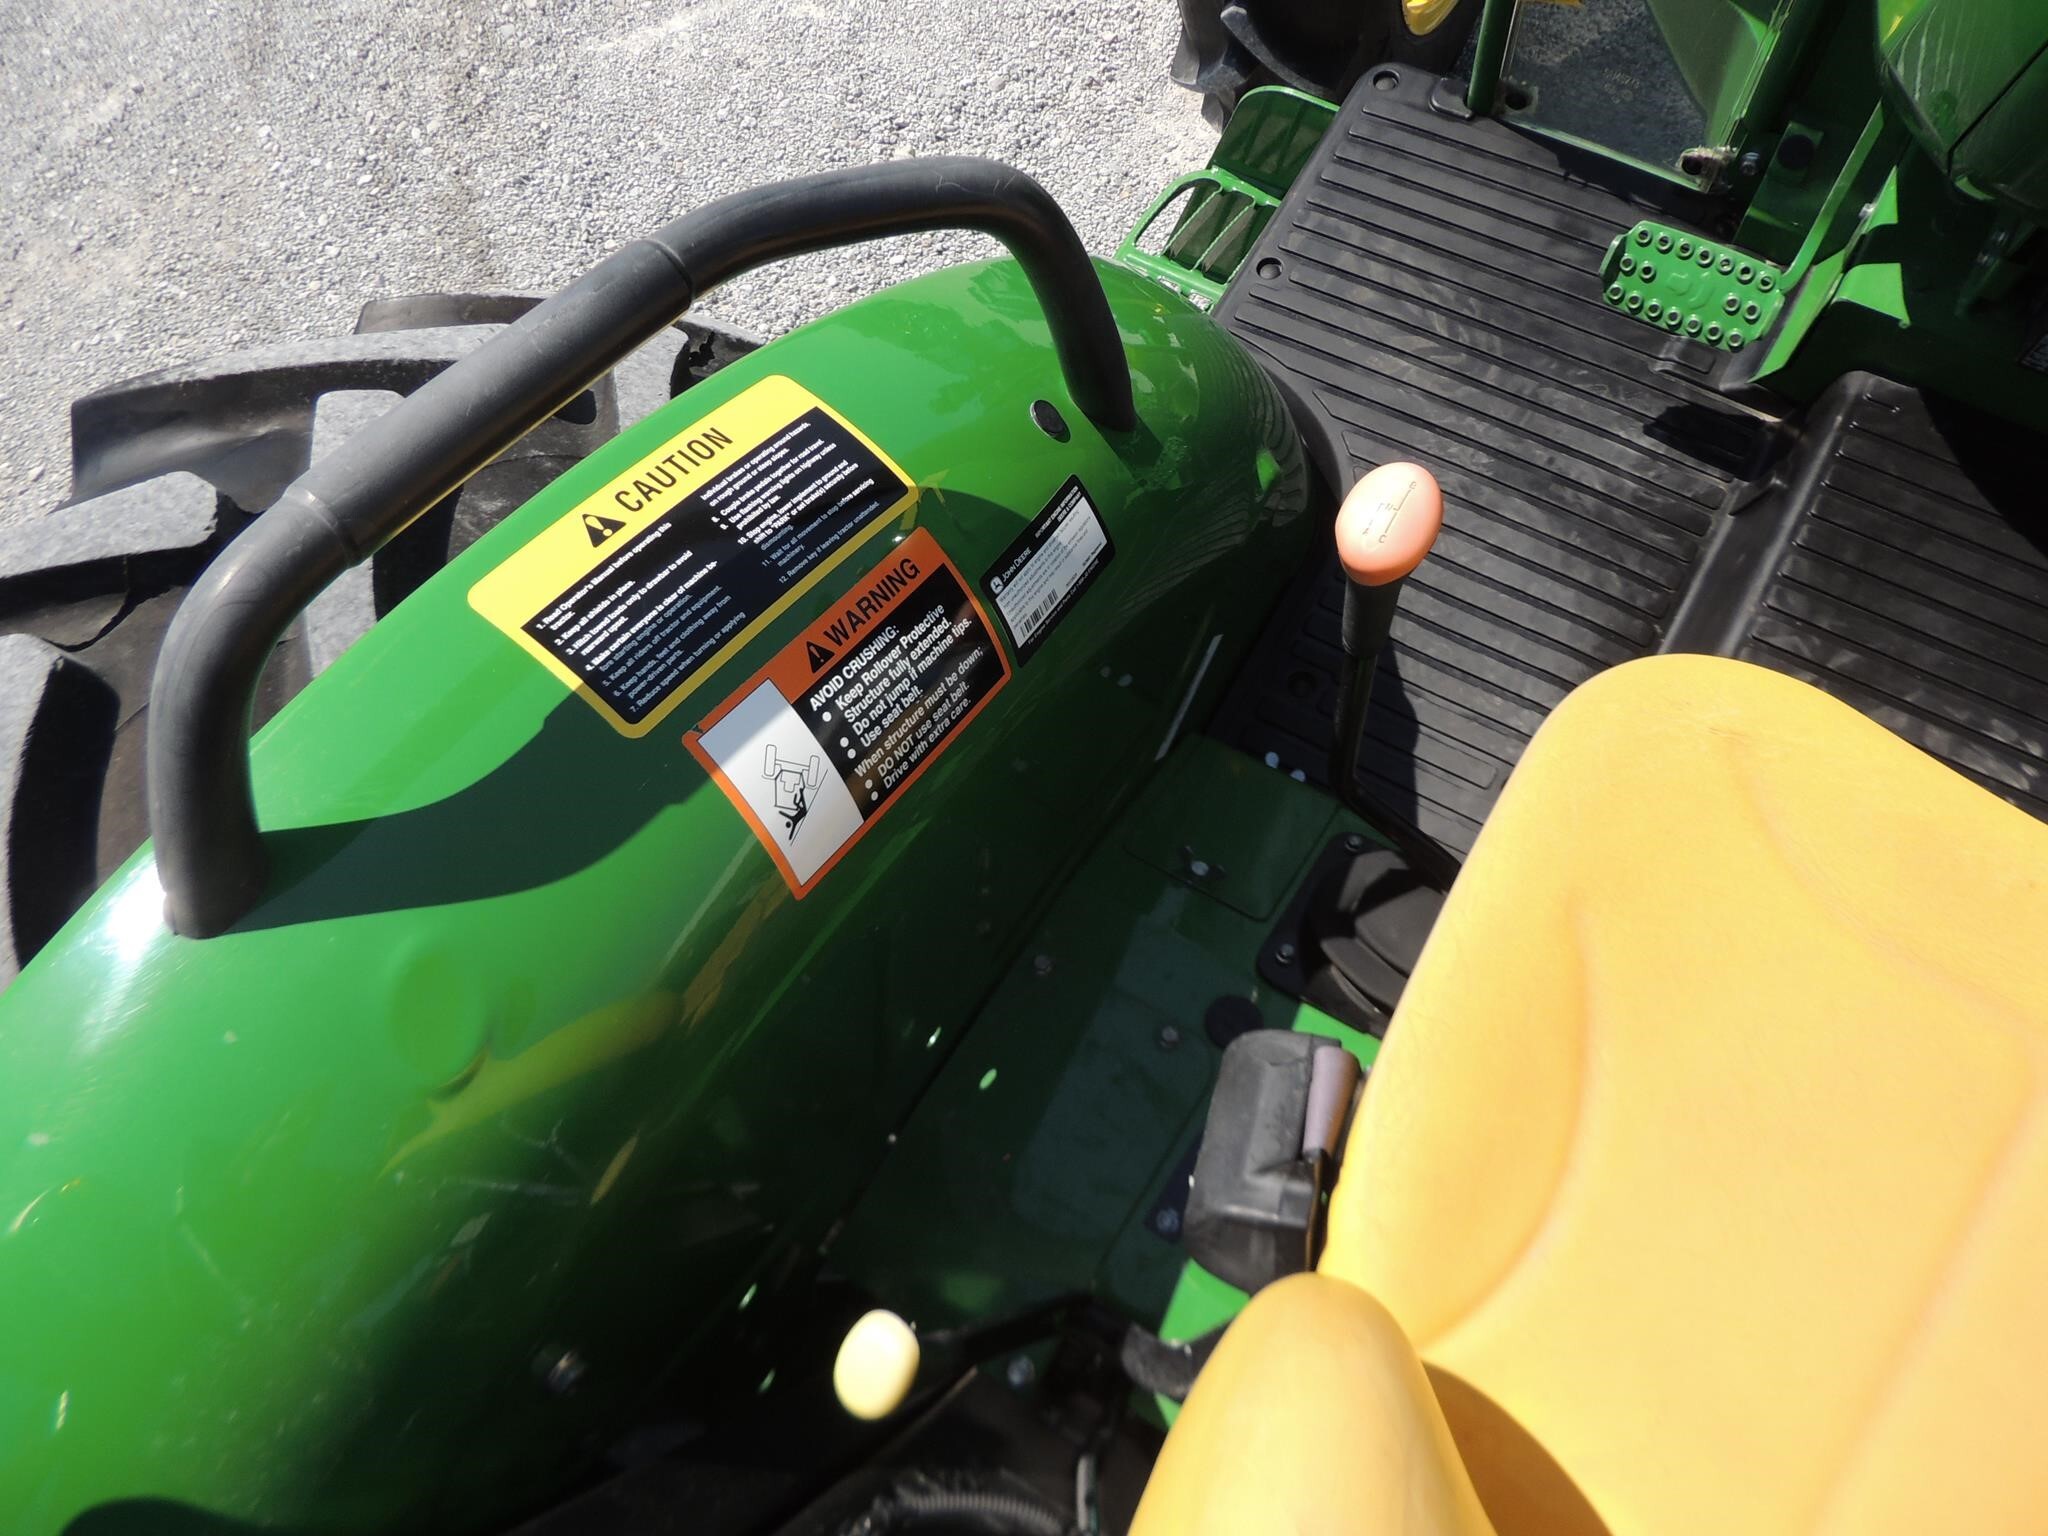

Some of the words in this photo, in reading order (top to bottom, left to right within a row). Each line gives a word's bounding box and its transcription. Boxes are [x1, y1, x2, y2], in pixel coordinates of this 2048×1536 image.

[615, 427, 731, 511] CAUTION
[709, 498, 719, 506] on
[716, 487, 734, 500] rough
[732, 472, 752, 490] ground
[750, 468, 758, 476] or
[756, 459, 772, 471] steep
[770, 447, 789, 461] slopes.
[720, 499, 741, 515] Couple
[738, 488, 755, 502] brake
[753, 476, 772, 492] pedals
[769, 461, 791, 478] together
[789, 456, 799, 464] for
[797, 447, 810, 459] road
[725, 467, 745, 481] brakes
[749, 446, 775, 464] operating
[772, 433, 791, 448] around
[728, 512, 742, 523] Use
[739, 497, 763, 516] flashing
[760, 482, 782, 499] warning
[778, 472, 795, 485] lights
[799, 453, 821, 469] highway
[819, 442, 836, 455] unless
[736, 506, 763, 530] prohibited
[760, 501, 771, 509] by
[767, 494, 780, 504] law.
[737, 536, 748, 544] 10.
[745, 526, 761, 538] Stop
[776, 501, 792, 514] lower
[790, 482, 817, 503] implement
[814, 478, 822, 487] to
[821, 465, 839, 482] ground
[837, 459, 848, 469] and
[753, 532, 767, 544] shift
[770, 512, 790, 528] "PARK"
[796, 501, 806, 511] set
[803, 486, 825, 504] brake(s)
[823, 473, 844, 489] securely
[841, 462, 858, 475] before
[769, 548, 783, 559] Wait
[781, 542, 790, 550] for
[790, 536, 798, 544] all
[796, 517, 822, 539] movement
[826, 505, 838, 515] stop
[837, 493, 853, 506] before
[851, 478, 874, 496] servicing
[542, 608, 562, 624] Read
[559, 583, 593, 610] Operator's
[590, 565, 615, 585] Manual
[611, 551, 633, 568] before
[631, 530, 661, 553] operating
[657, 522, 671, 532] this
[786, 558, 808, 576] Remove
[806, 550, 818, 560] key
[819, 533, 839, 549] leaving
[836, 520, 853, 535] tractor
[1002, 564, 1016, 582] JOHN
[1013, 546, 1031, 567] DEERE
[549, 611, 575, 630] tractor.
[560, 624, 580, 639] Keep
[578, 616, 589, 626] all
[586, 599, 610, 619] shields
[607, 593, 617, 601] in
[615, 580, 635, 596] place.
[565, 647, 575, 655] 3.
[572, 633, 592, 649] Hitch
[588, 616, 610, 635] towed
[607, 604, 627, 619] loads
[625, 592, 641, 605] only
[645, 568, 670, 589] drawbar
[675, 550, 692, 565] avoid
[580, 630, 609, 655] rearward
[607, 615, 628, 632] upset.
[590, 649, 611, 665] Make
[608, 631, 631, 651] certain
[629, 609, 658, 633] everyone
[662, 591, 678, 606] clear
[676, 585, 685, 594] of
[683, 567, 708, 588] machine
[619, 675, 637, 690] Keep
[655, 647, 669, 659] feet
[668, 636, 681, 649] and
[679, 618, 704, 639] clothing
[702, 606, 718, 620] away
[715, 595, 731, 607] from
[823, 558, 919, 645] WARNING
[598, 659, 614, 671] fore
[612, 639, 638, 660] starting
[635, 622, 657, 640] engine
[655, 616, 664, 624] or
[608, 665, 627, 680] Keep
[625, 657, 635, 667] all
[633, 643, 652, 659] riders
[651, 634, 661, 644] off
[659, 619, 680, 636] tractor
[679, 608, 692, 620] and
[627, 663, 666, 698] power-driven
[665, 649, 683, 665] parts.
[636, 685, 661, 706] Reduce
[659, 668, 679, 686] speed
[677, 655, 695, 670] when
[692, 637, 716, 656] turning
[713, 631, 721, 639] or
[720, 611, 745, 633] applying
[810, 675, 843, 710] AVOID
[842, 626, 898, 678] CRUSHING:
[834, 682, 863, 713] Keep
[860, 645, 901, 685] Rollover
[899, 605, 944, 648] Protective
[844, 677, 890, 725] Structure
[888, 656, 912, 680] fully
[910, 617, 951, 660] extended.
[852, 717, 869, 739] Do
[868, 699, 887, 720] not
[884, 677, 911, 707] jump
[907, 666, 918, 680] if
[917, 634, 953, 672] machine
[951, 617, 971, 637] tips.
[854, 747, 884, 776] When
[884, 706, 924, 749] structure
[924, 682, 946, 709] must
[944, 672, 958, 686] be
[957, 646, 982, 674] down;
[860, 725, 881, 746] Use
[881, 703, 903, 728] seat
[900, 685, 922, 707] belt.
[877, 756, 893, 776] DO
[893, 733, 913, 760] NOT
[915, 719, 932, 738] use
[932, 698, 951, 721] seat
[949, 681, 969, 702] belt.
[883, 760, 908, 788] Drive
[908, 740, 928, 762] with
[928, 717, 950, 742] extra
[950, 698, 970, 719] care.
